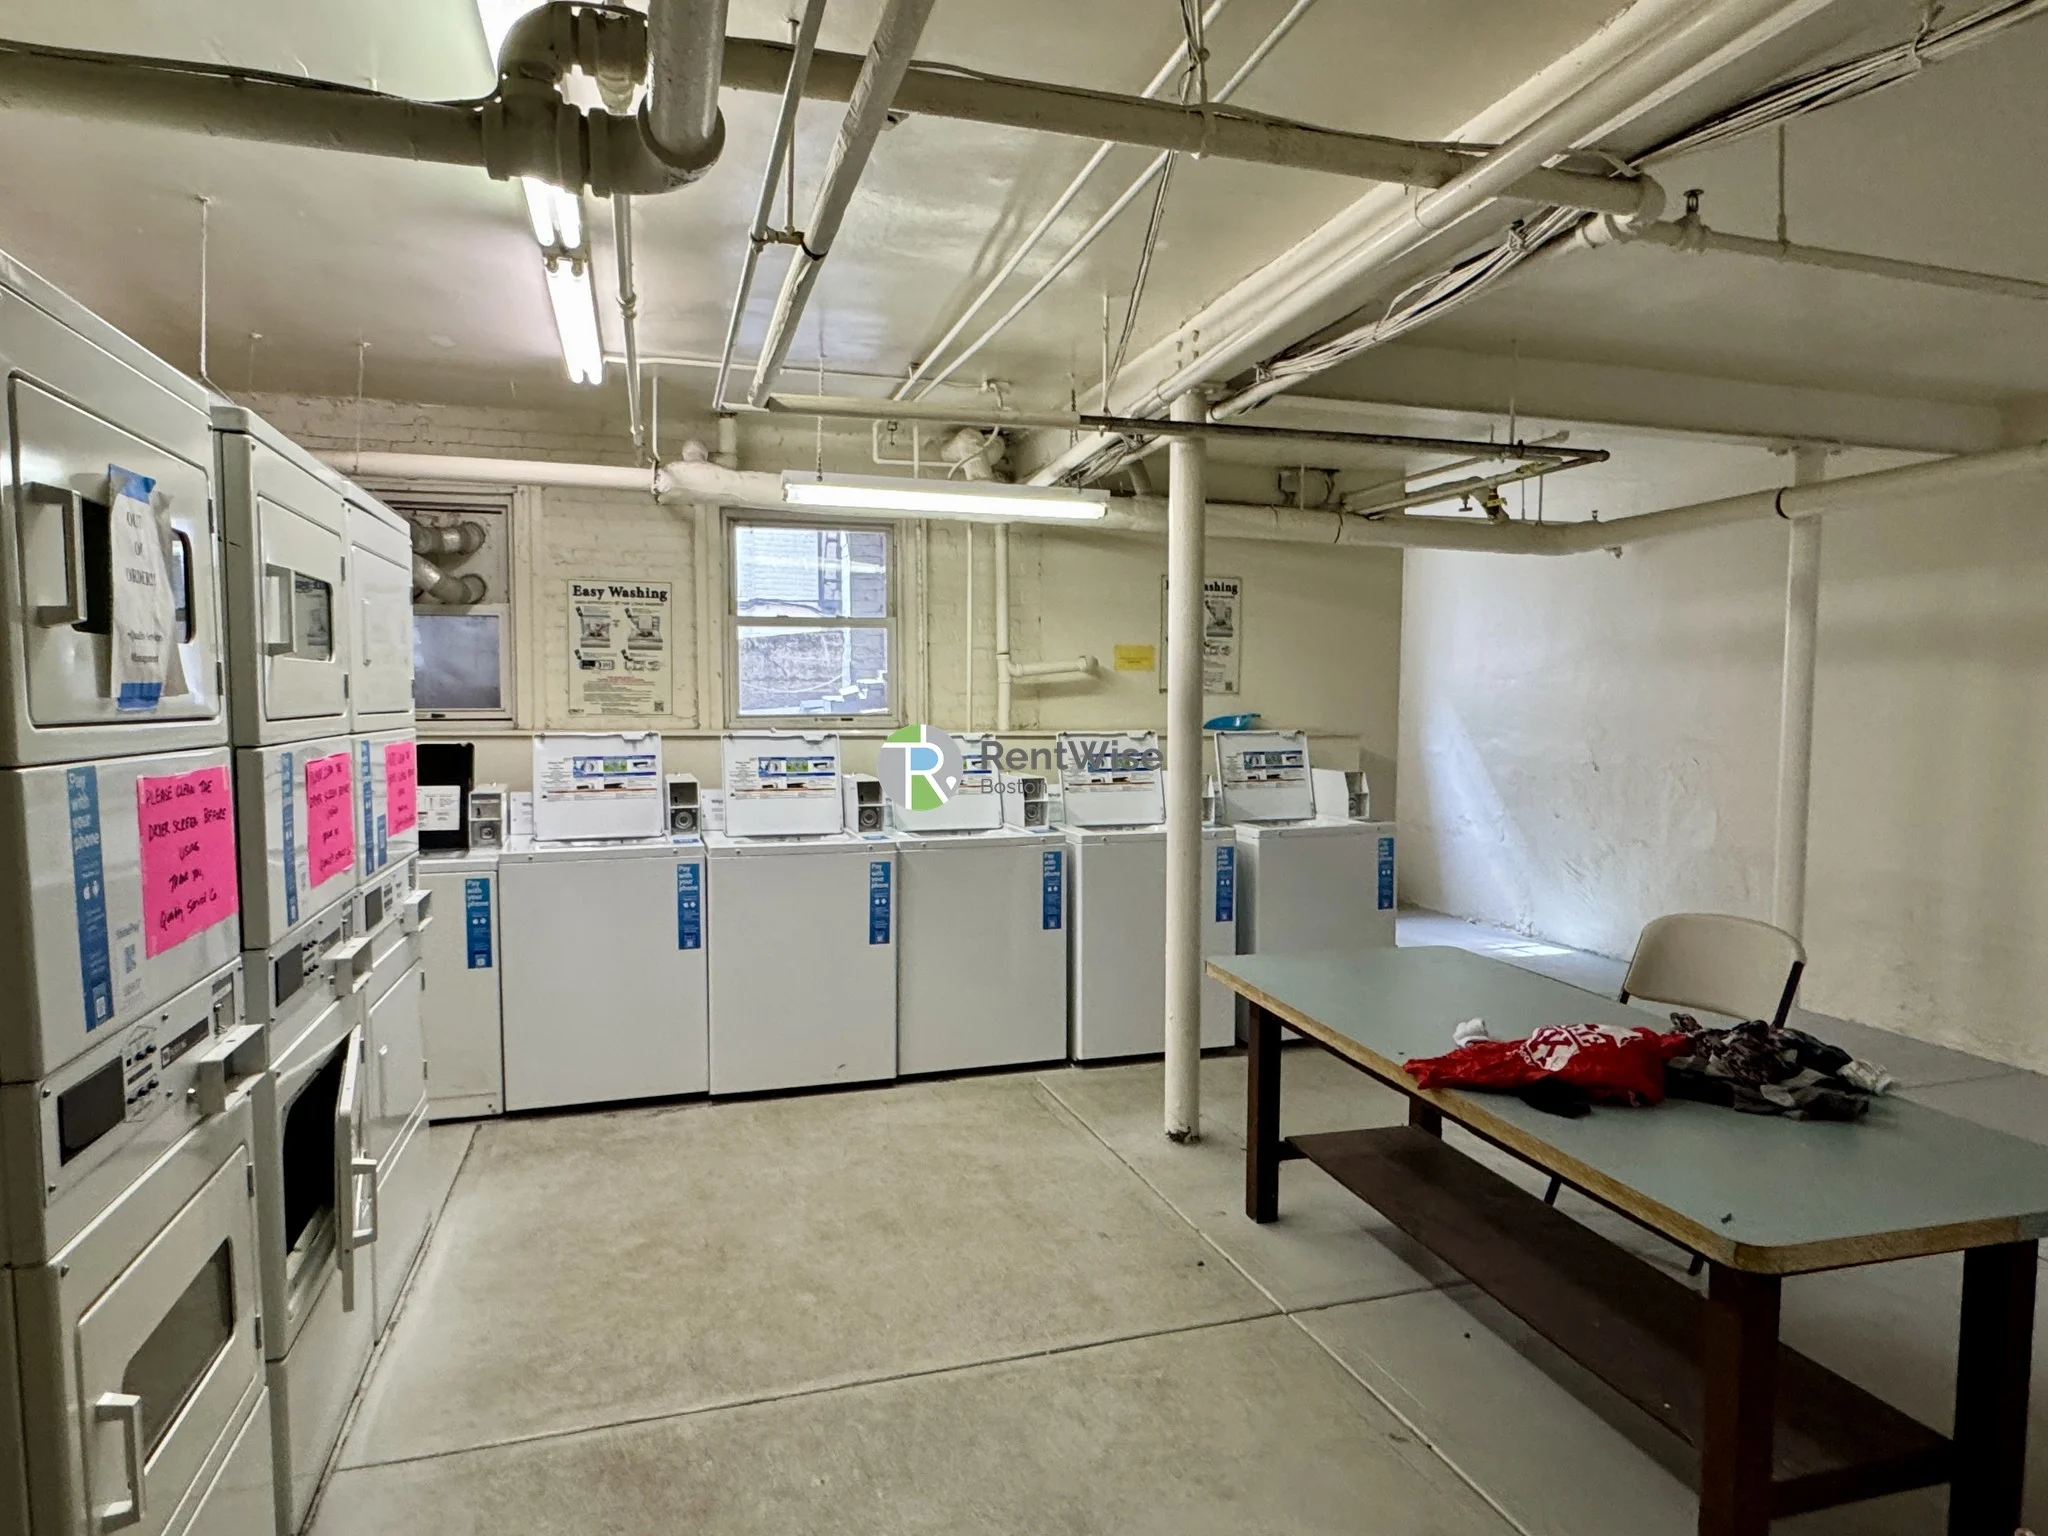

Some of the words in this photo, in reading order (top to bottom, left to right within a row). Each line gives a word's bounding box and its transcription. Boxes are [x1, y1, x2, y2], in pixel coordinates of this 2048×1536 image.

[1204, 581, 1238, 595] ashing
[572, 585, 605, 600] Easy
[608, 586, 668, 602] Washing
[145, 785, 173, 807] PLEASE
[74, 832, 100, 852] phone
[871, 863, 883, 871] Pay
[1044, 870, 1060, 878] phone
[466, 880, 480, 889] Pay
[678, 885, 698, 893] phone
[467, 901, 489, 909] phone
